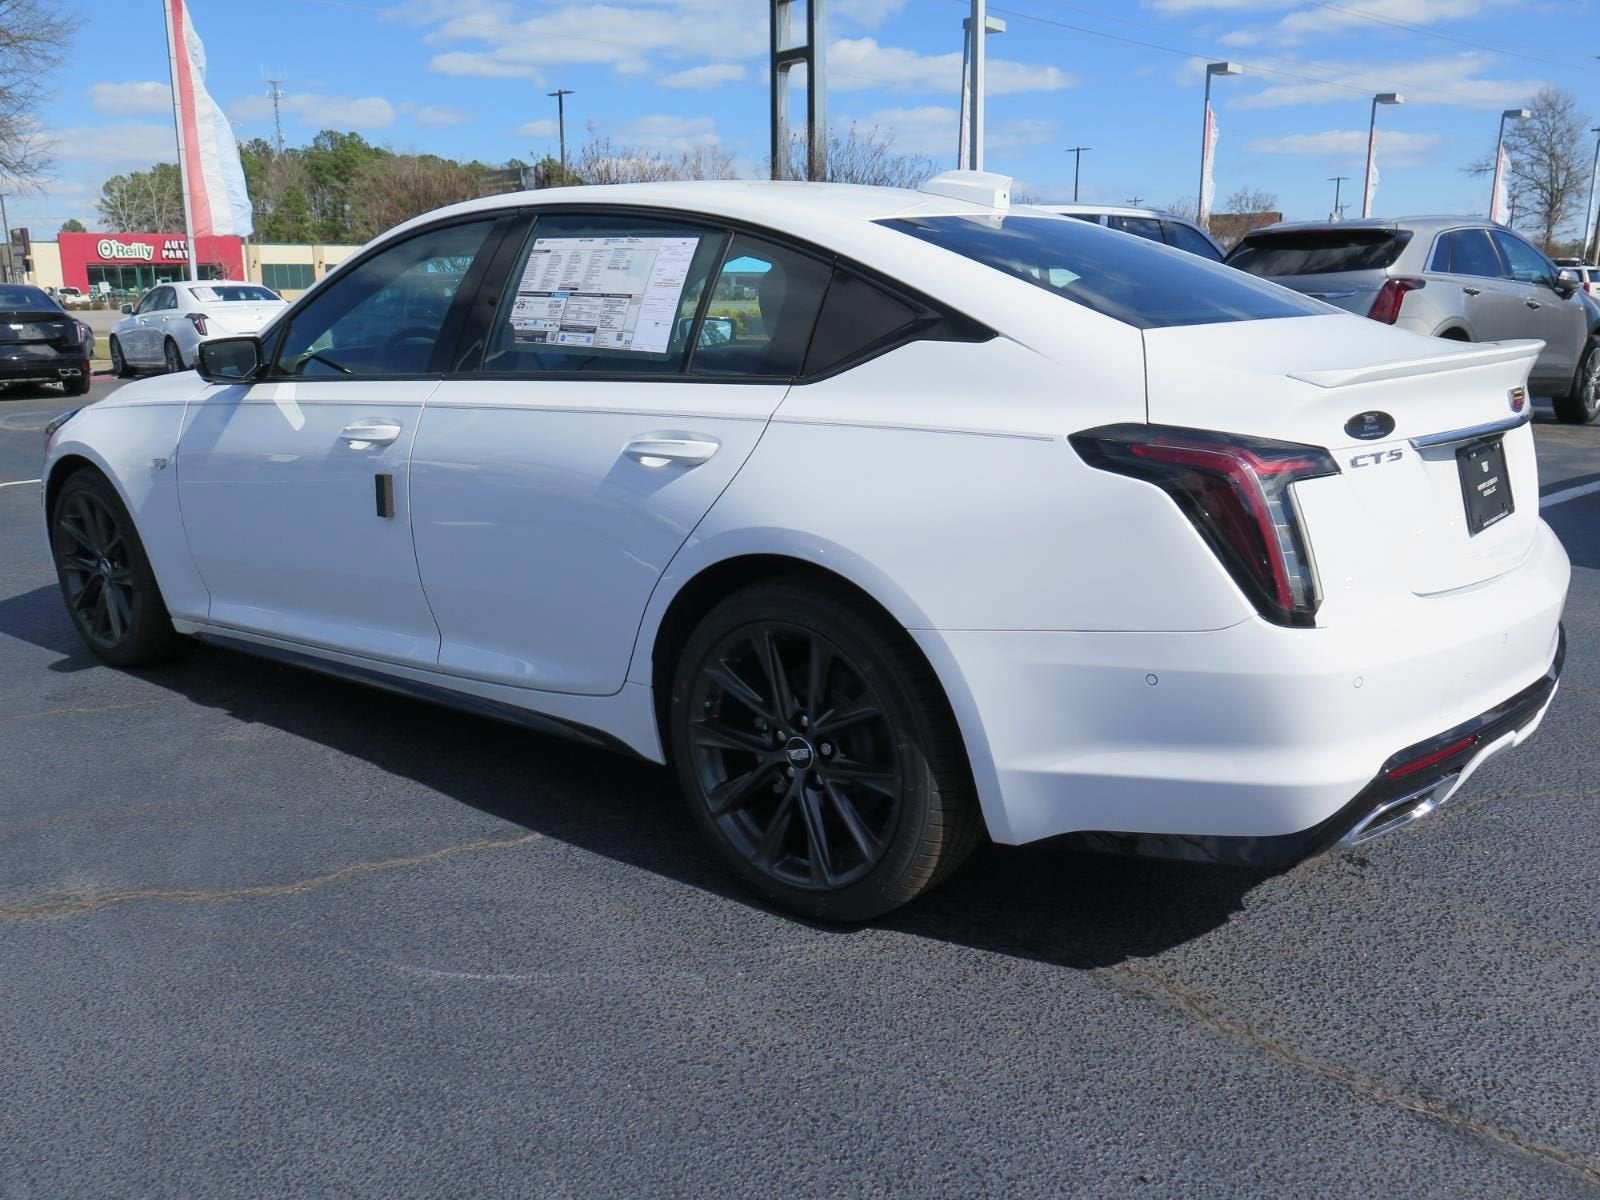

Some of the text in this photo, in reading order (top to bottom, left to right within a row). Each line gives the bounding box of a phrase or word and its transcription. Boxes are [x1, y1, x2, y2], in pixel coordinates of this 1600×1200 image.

[164, 240, 188, 249] AUT
[98, 240, 153, 259] O'Reilly
[161, 250, 188, 259] PART
